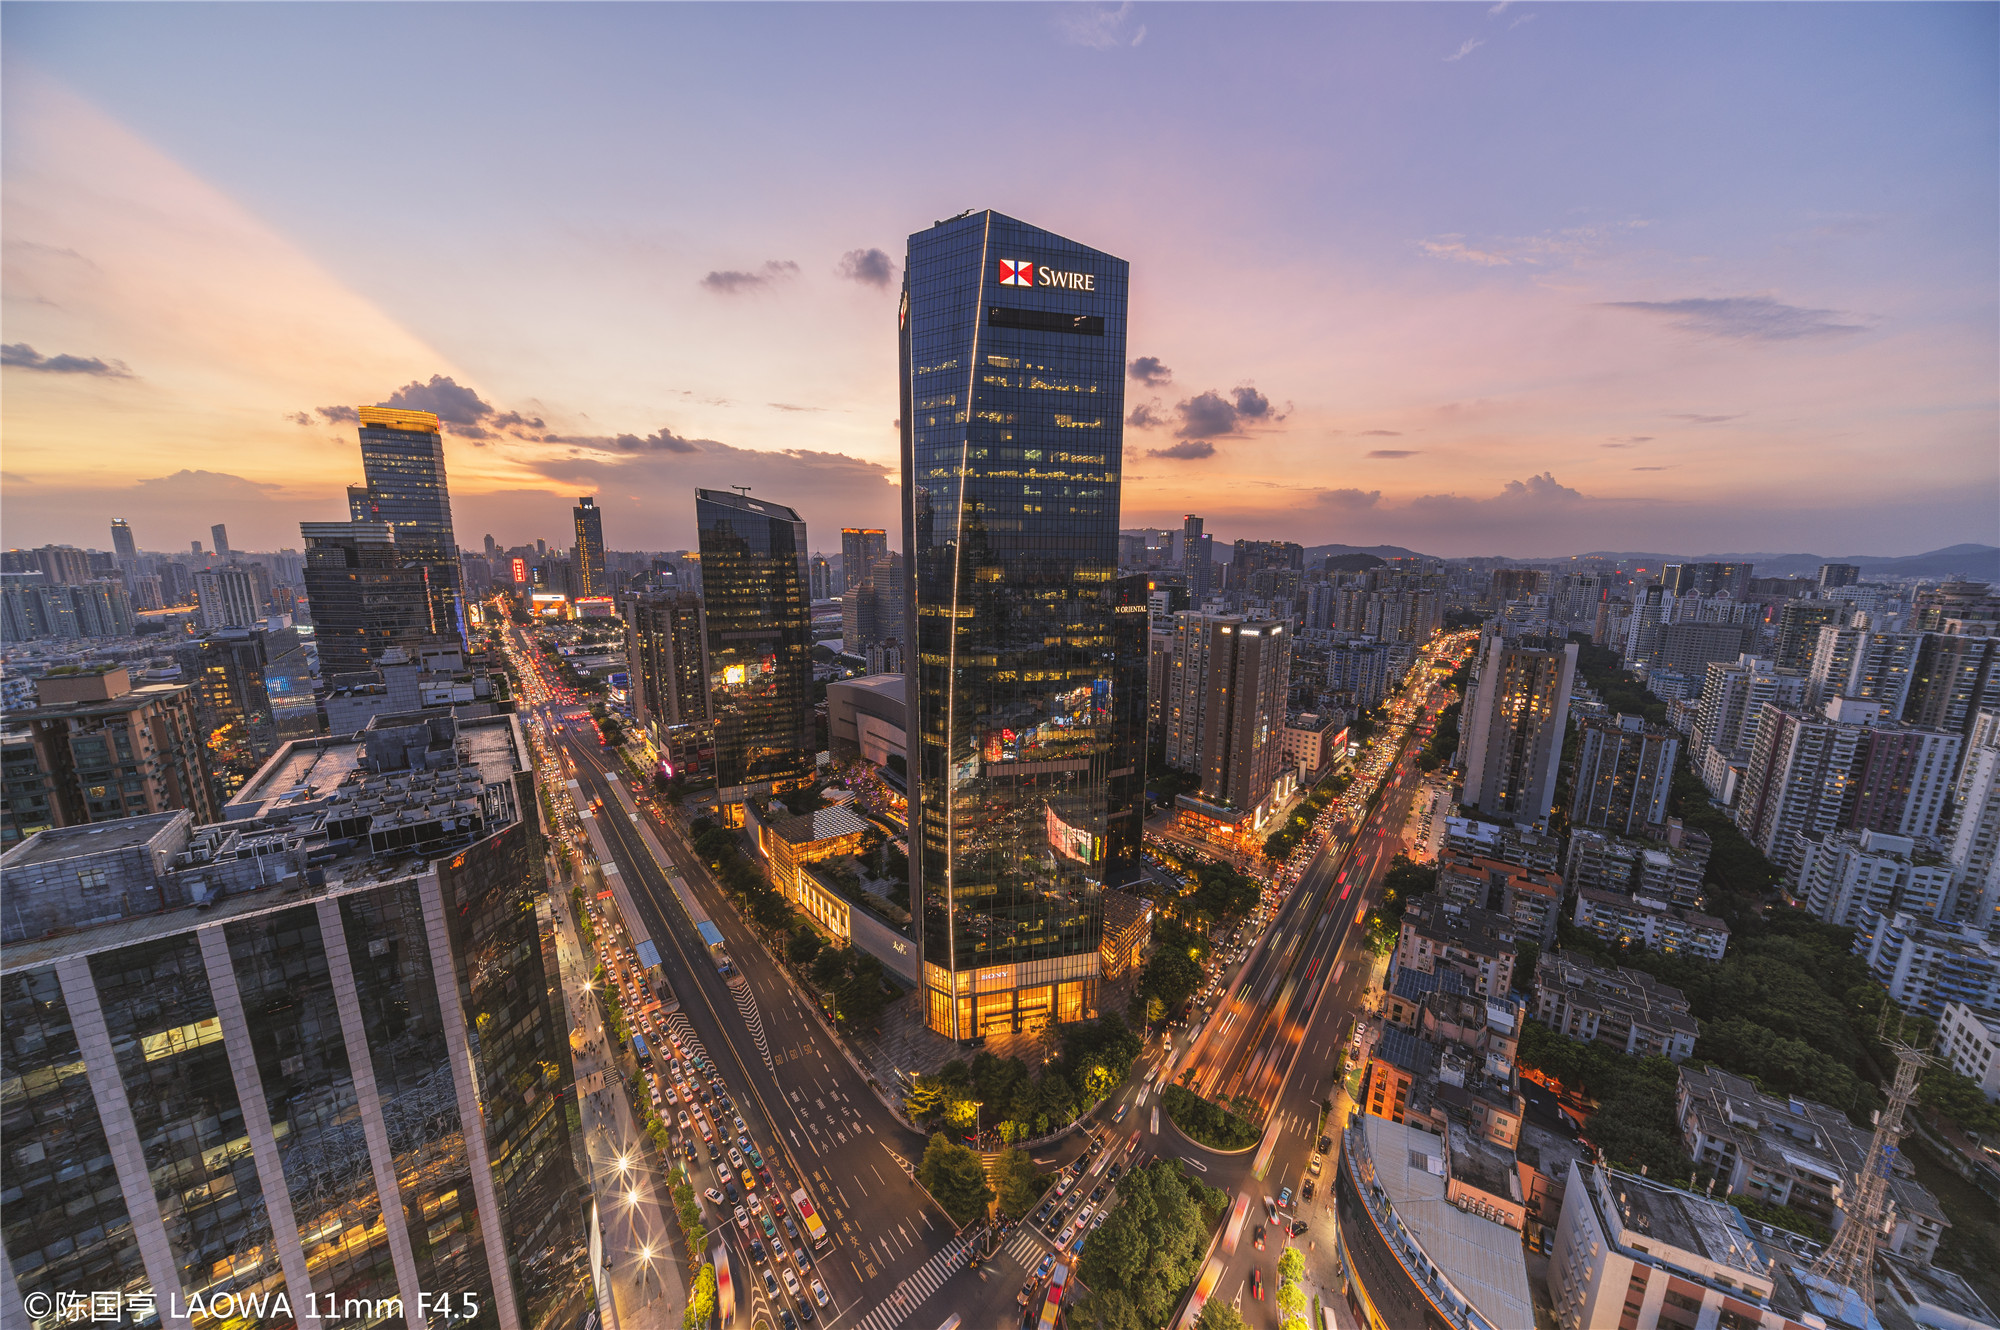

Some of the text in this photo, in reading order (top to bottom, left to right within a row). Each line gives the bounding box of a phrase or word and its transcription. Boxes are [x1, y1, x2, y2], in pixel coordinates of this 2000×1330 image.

[1038, 266, 1095, 291] SWIRE
[1120, 605, 1147, 613] ORIENTAL
[981, 971, 1008, 980] SONY
